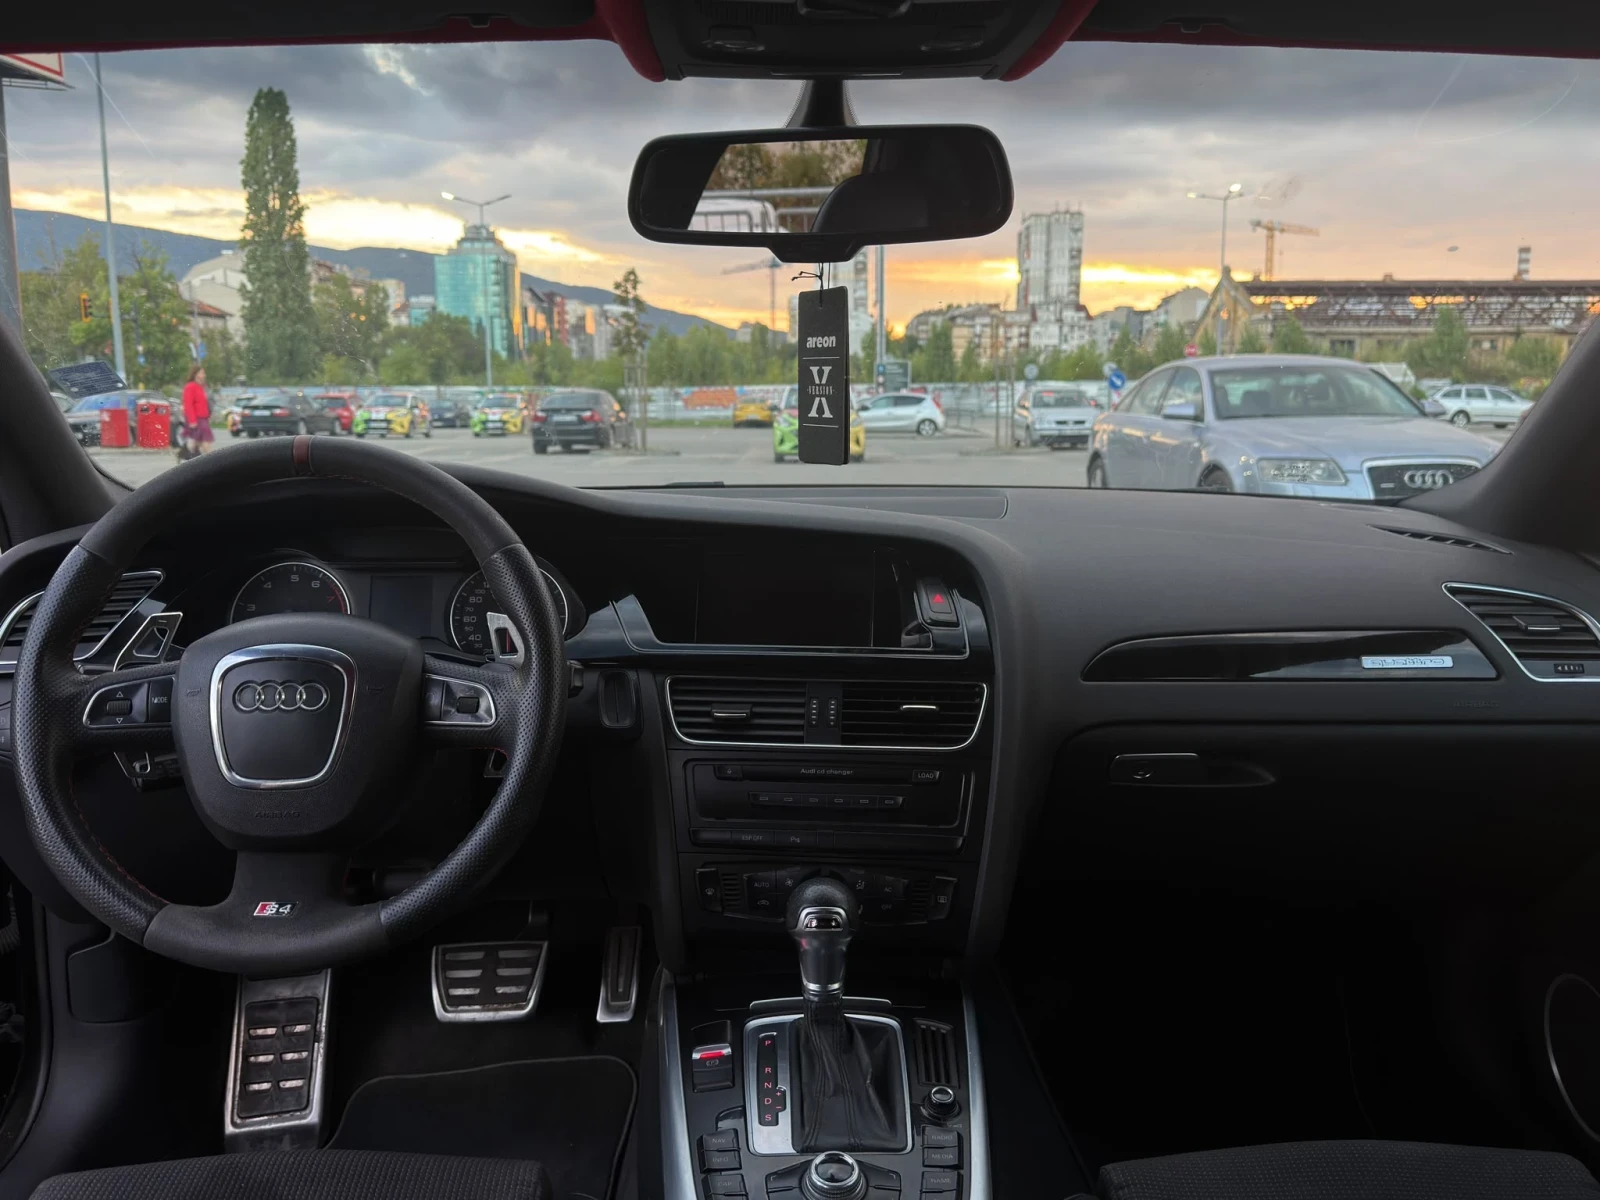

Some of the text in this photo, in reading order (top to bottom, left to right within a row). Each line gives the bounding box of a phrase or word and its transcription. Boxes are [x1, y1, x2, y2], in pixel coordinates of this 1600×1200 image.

[806, 335, 836, 349] areon
[290, 574, 300, 582] 5
[263, 581, 272, 589] 4
[311, 580, 321, 588] 6
[246, 603, 256, 612] 3
[463, 615, 477, 623] 60
[151, 696, 169, 704] MODE
[800, 767, 816, 775] Audi
[826, 768, 854, 776] changer
[917, 771, 934, 779] LOAD
[764, 1039, 772, 1047] P
[764, 1066, 772, 1074] R
[764, 1081, 772, 1089] N
[764, 1097, 772, 1105] D
[764, 1113, 772, 1121] S
